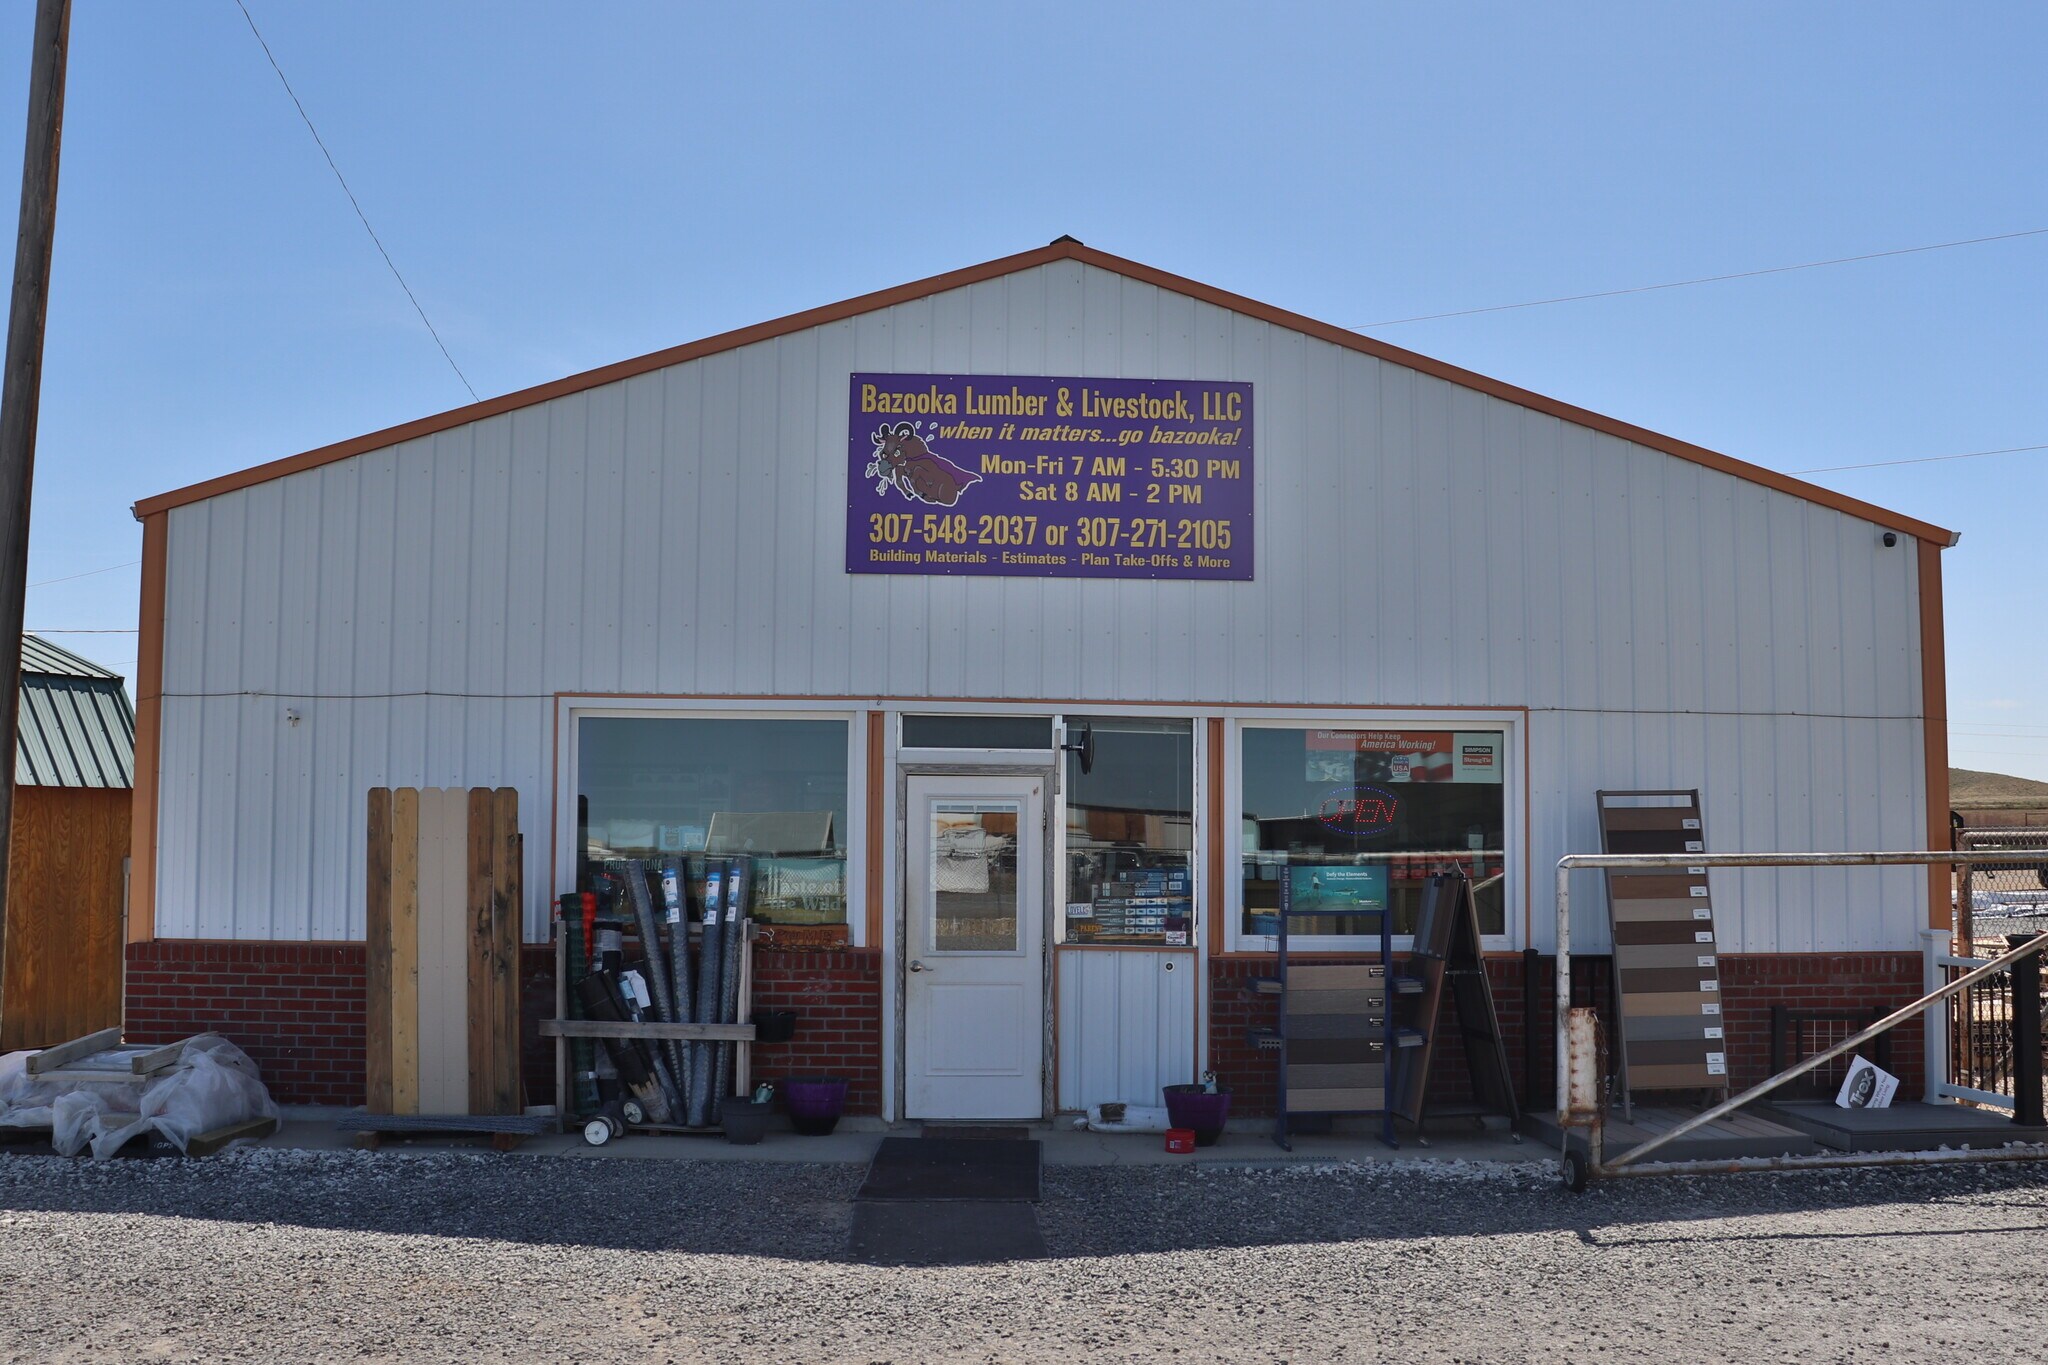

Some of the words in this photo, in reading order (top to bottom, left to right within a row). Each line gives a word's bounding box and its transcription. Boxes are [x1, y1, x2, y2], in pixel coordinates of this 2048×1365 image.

[862, 383, 957, 415] Bazooka
[965, 386, 1048, 416] Lumber
[1056, 387, 1073, 417] &
[1082, 389, 1195, 423] Livestock,
[1203, 391, 1242, 421] LLC
[941, 421, 993, 439] when
[999, 424, 1015, 440] it
[1150, 425, 1242, 446] bazooka!
[981, 454, 1064, 474] Mon-Fri
[1072, 456, 1083, 475] 7
[1091, 457, 1126, 476] AM
[1151, 457, 1199, 478] 5:30
[1207, 460, 1240, 478] PM
[1020, 481, 1057, 501] Sat
[1065, 482, 1079, 501] 8
[1087, 482, 1121, 502] AM
[1148, 483, 1160, 503] 2
[1169, 484, 1202, 503] PM
[869, 513, 1037, 545] 307-548-2037
[1045, 525, 1068, 545] or
[1077, 517, 1231, 549] 307-271-2105
[870, 549, 921, 562] Building
[925, 551, 988, 563] Materials
[1002, 553, 1066, 565] Estimates
[1082, 553, 1110, 565] Plan
[1114, 554, 1179, 567] Take-Offs
[1183, 555, 1193, 567] &
[1198, 556, 1231, 568] More
[1317, 731, 1329, 739] Our
[1330, 731, 1367, 740] Connectors
[1368, 732, 1383, 742] Help
[1384, 732, 1401, 742] Keep
[1360, 739, 1396, 749] America
[1398, 740, 1436, 750] Working!
[1318, 798, 1398, 823] OPEN
[1849, 1070, 1875, 1105] Trex
